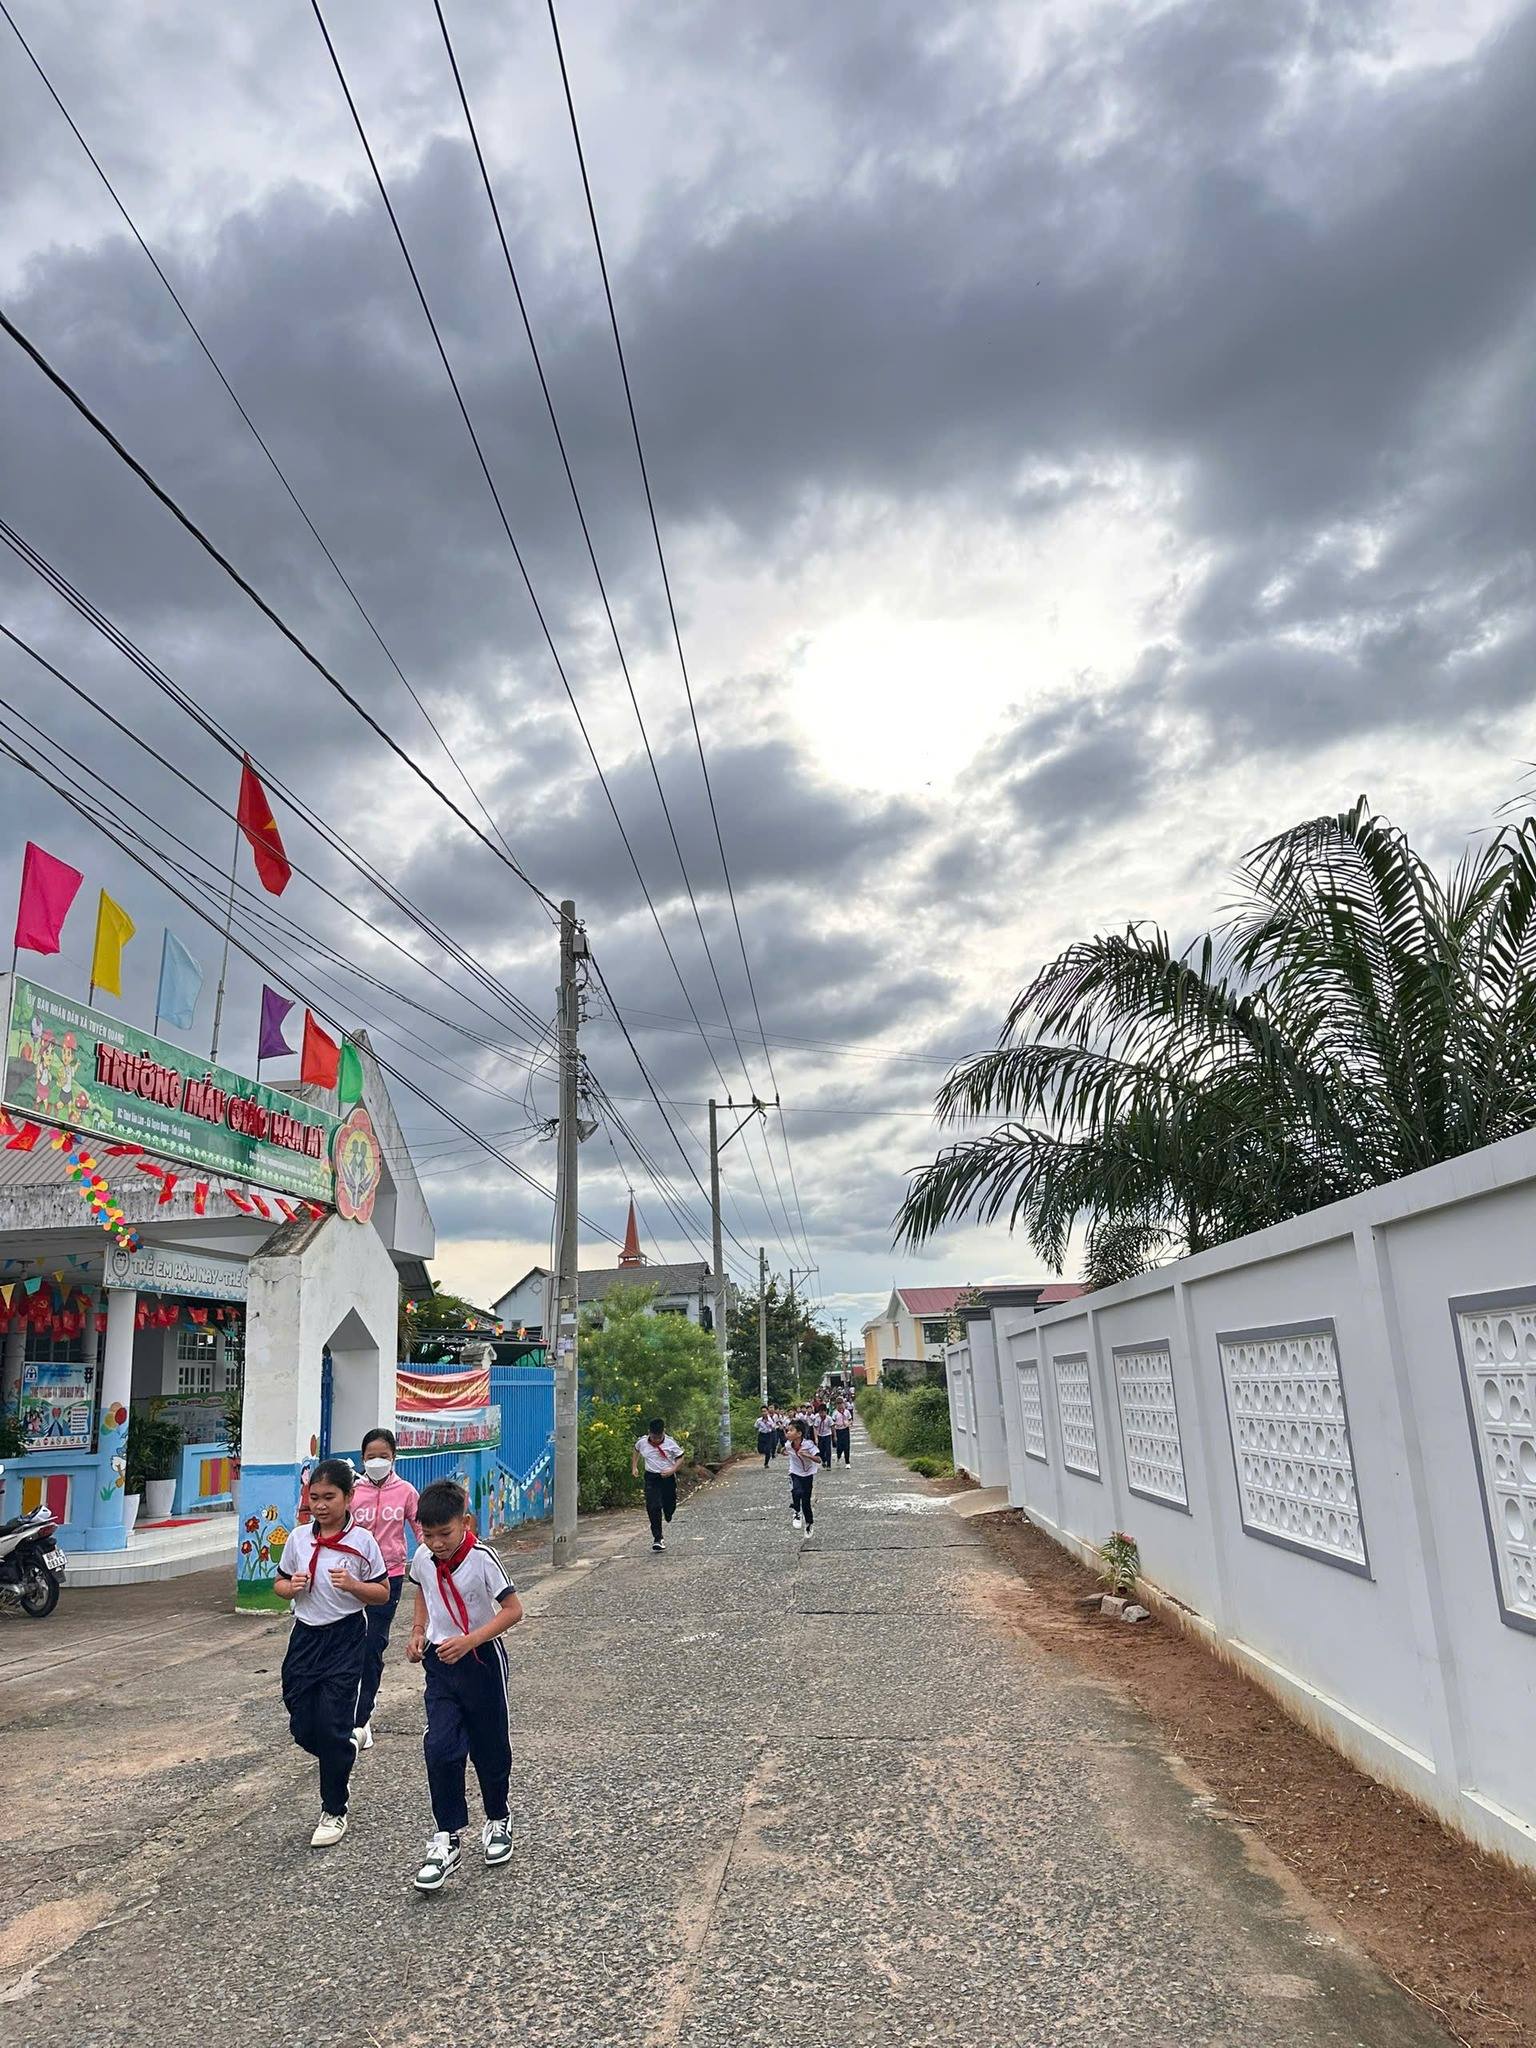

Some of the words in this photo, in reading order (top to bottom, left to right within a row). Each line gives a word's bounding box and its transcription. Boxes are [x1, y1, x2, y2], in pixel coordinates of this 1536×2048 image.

[36, 997, 50, 1013] BAN
[50, 1003, 66, 1021] NHÂN
[66, 1008, 79, 1026] DÂN
[107, 1028, 125, 1046] QUANG
[94, 1040, 183, 1109] TRƯỜNG
[183, 1071, 226, 1125] MẪU
[227, 1093, 269, 1141] GIÁO
[132, 1255, 154, 1276] TRẺ
[155, 1260, 173, 1279] EM
[173, 1261, 198, 1282] HÔM
[197, 1265, 220, 1285] NAY
